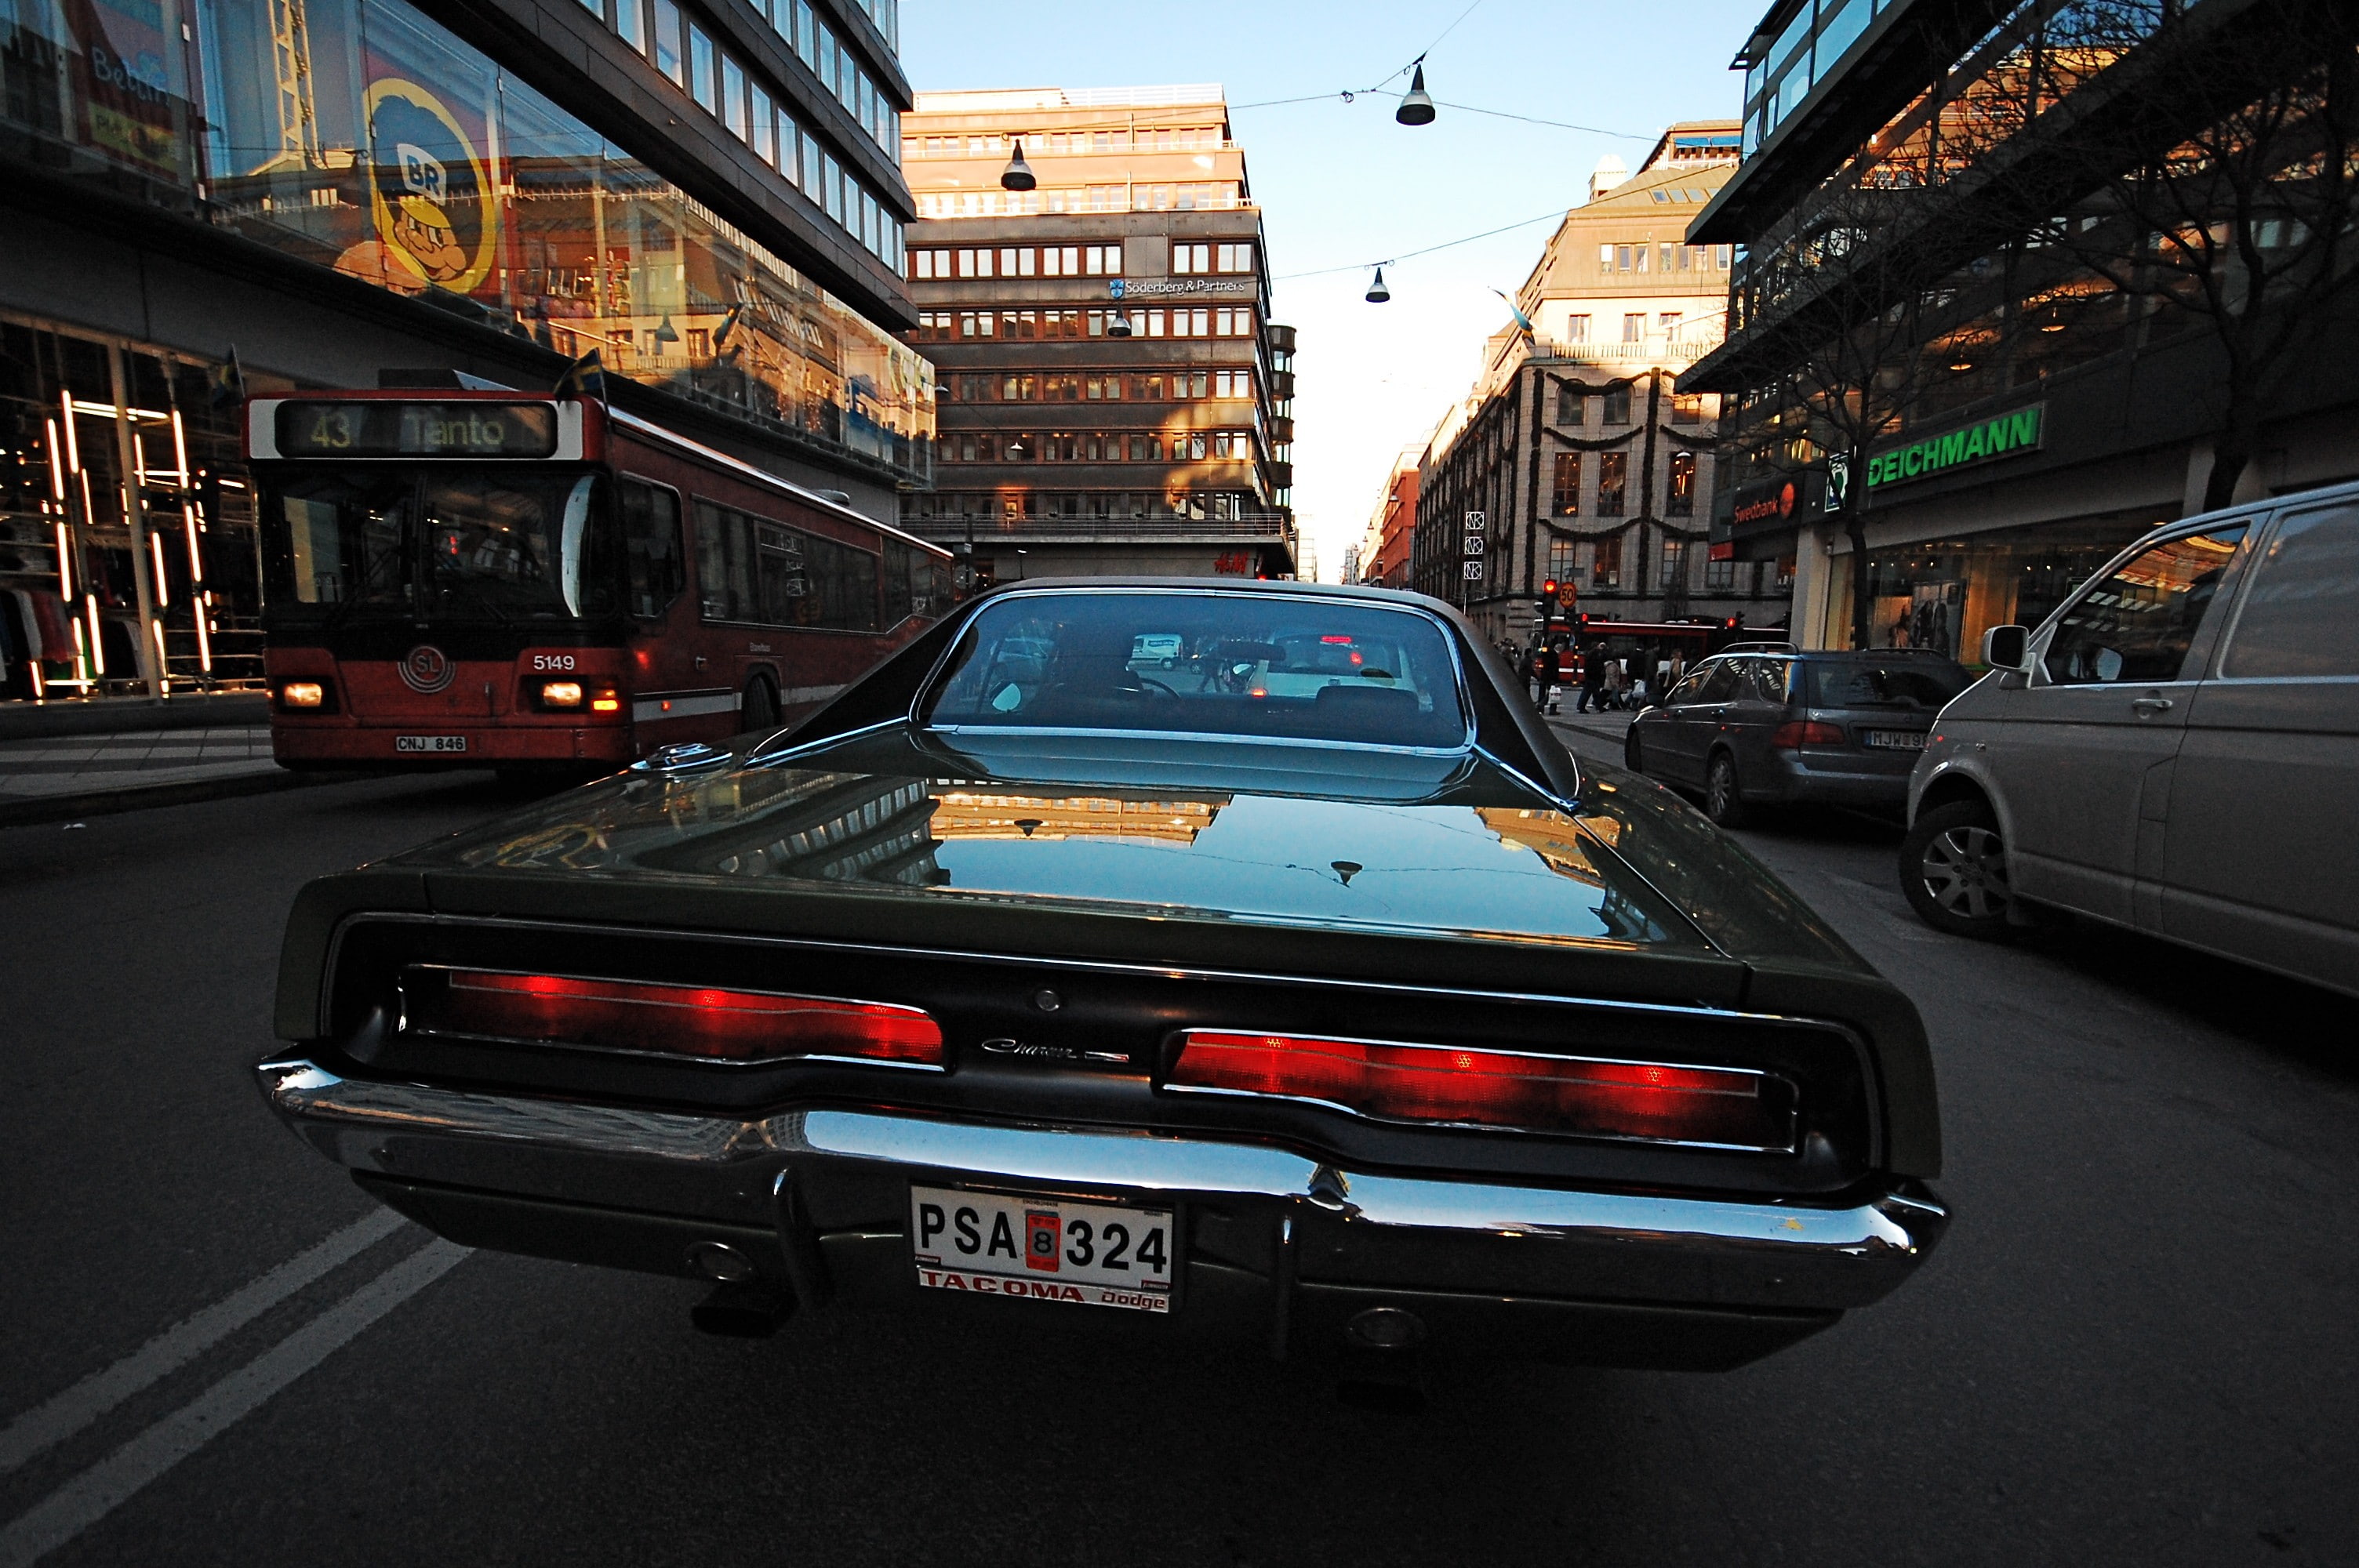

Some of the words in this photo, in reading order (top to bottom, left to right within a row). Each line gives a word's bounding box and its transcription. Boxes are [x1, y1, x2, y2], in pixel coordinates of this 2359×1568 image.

[406, 154, 441, 196] BR
[1125, 281, 1184, 296] Söderberg
[1186, 281, 1194, 291] &
[1197, 280, 1245, 292] Partners
[311, 412, 352, 448] 43
[404, 412, 503, 446] Tanto
[1867, 408, 2043, 488] DEICHMANN
[1734, 496, 1779, 524] Swedbank
[1466, 512, 1484, 529] NK
[1465, 537, 1483, 554] NK
[1464, 562, 1481, 579] NK
[1561, 588, 1574, 601] 50
[416, 655, 441, 674] SL
[533, 655, 575, 670] 5149
[398, 738, 426, 750] CNJ
[435, 738, 464, 750] 846
[1873, 731, 1902, 746] MJW
[920, 1203, 1018, 1260] PSA
[1067, 1220, 1167, 1274] 324
[1034, 1232, 1052, 1254] 8
[921, 1270, 1085, 1302] TACOMA
[1102, 1290, 1166, 1310] Dodge
